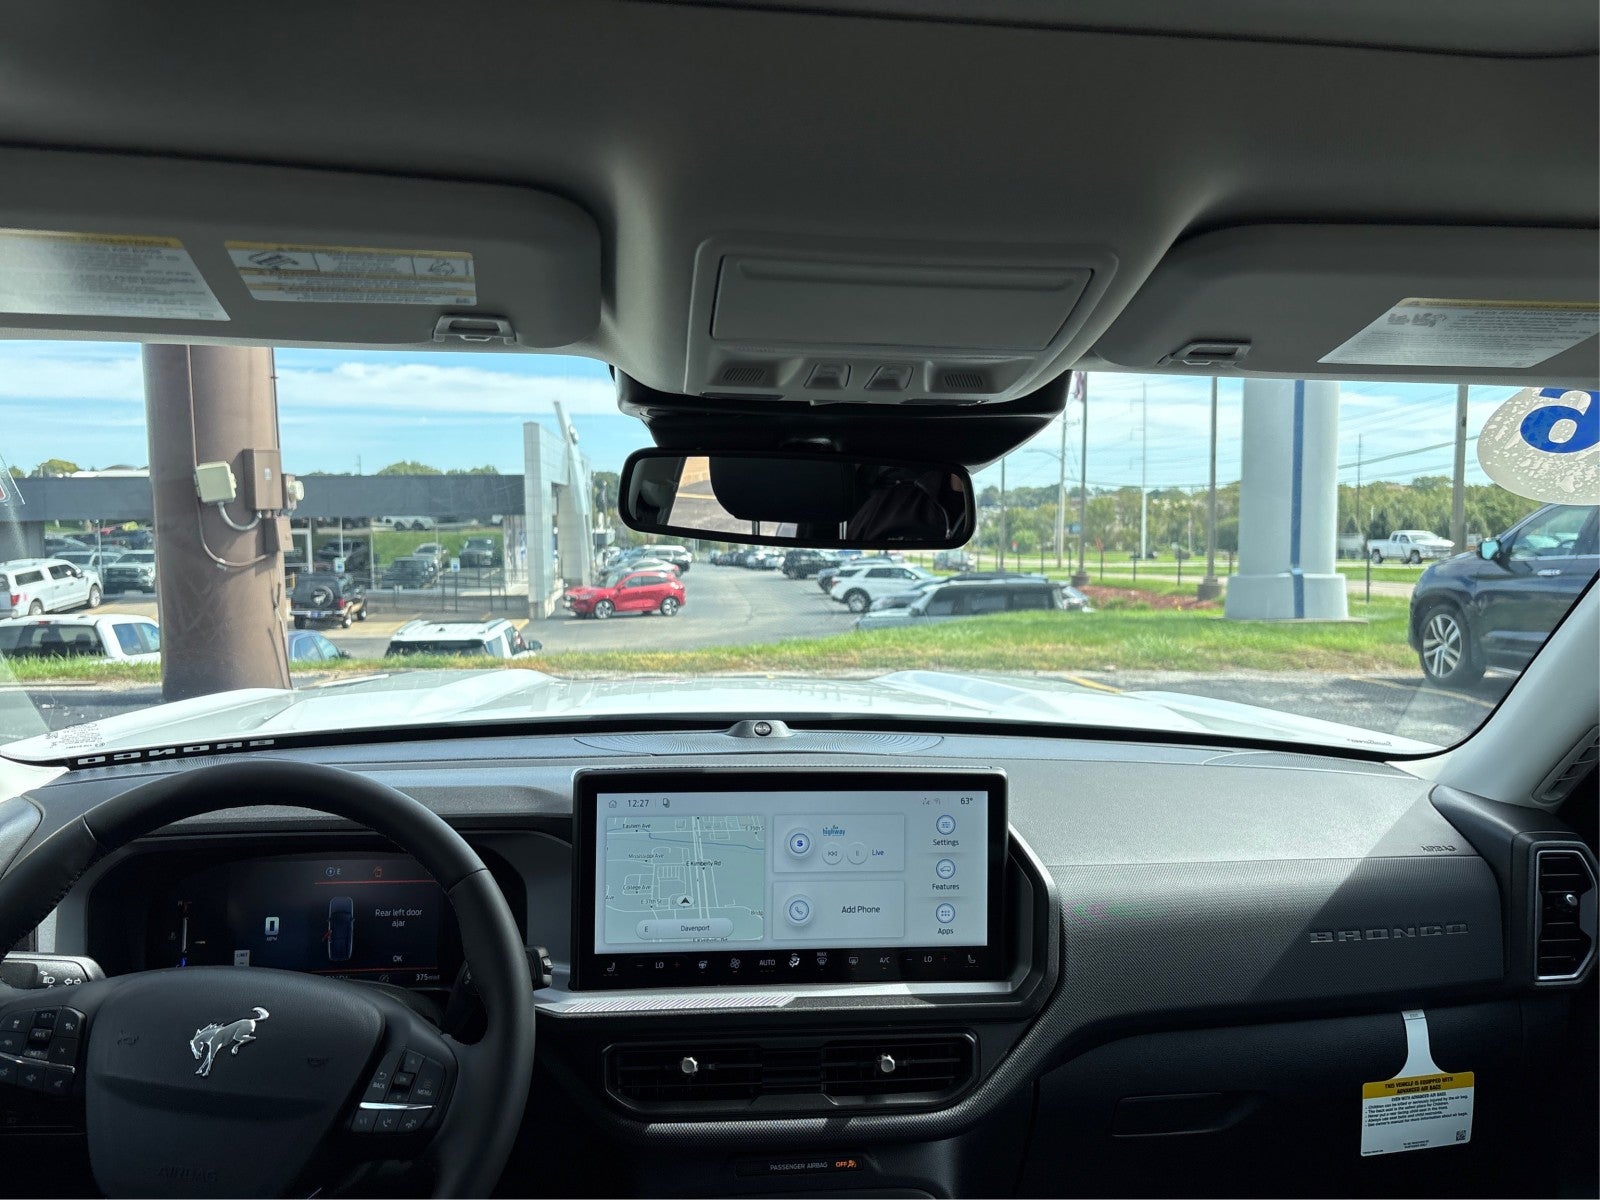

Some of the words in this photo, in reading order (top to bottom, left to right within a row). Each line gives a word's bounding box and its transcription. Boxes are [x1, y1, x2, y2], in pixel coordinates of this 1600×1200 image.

[627, 800, 649, 808] 12:27
[822, 827, 846, 836] highway
[375, 908, 391, 917] Rear
[841, 906, 856, 914] Add
[1310, 923, 1469, 943] BRONCO
